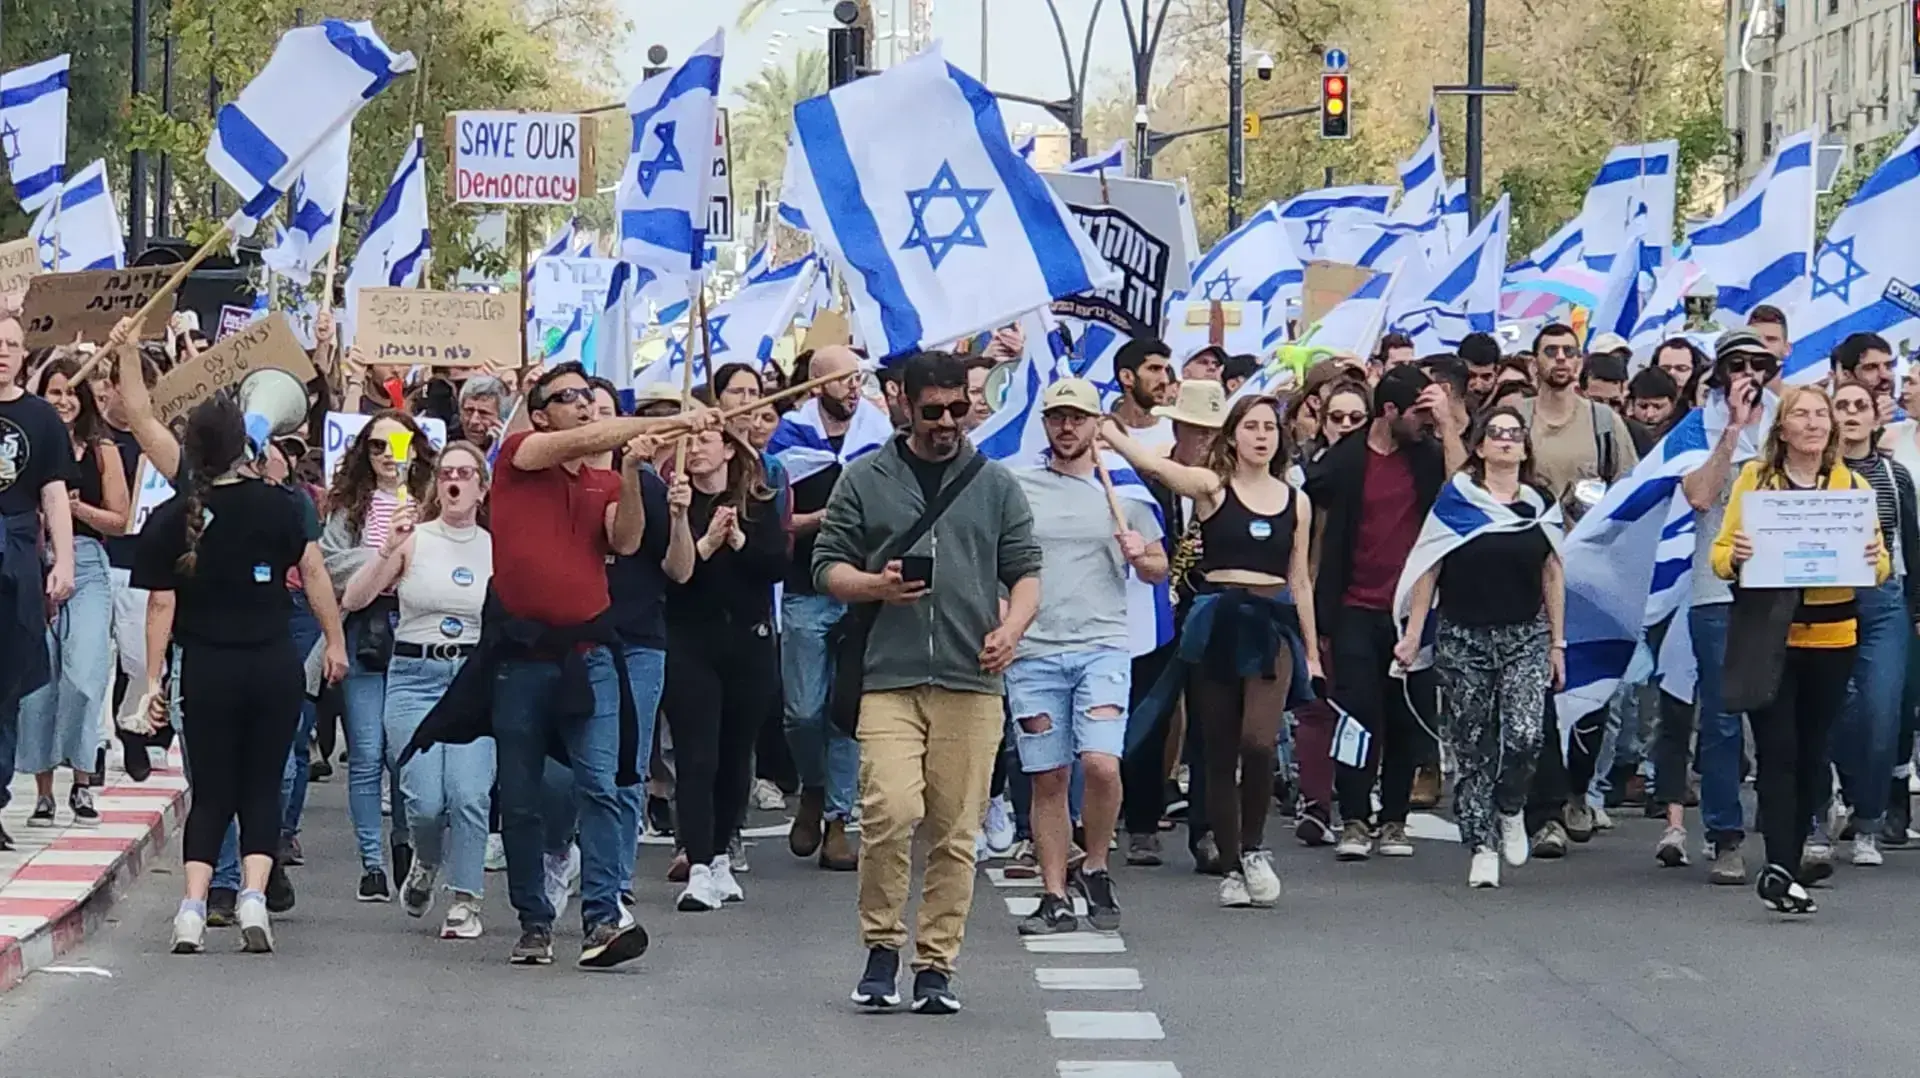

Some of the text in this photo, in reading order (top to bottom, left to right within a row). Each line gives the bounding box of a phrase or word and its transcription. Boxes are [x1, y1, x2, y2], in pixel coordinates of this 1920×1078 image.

[460, 120, 576, 159] SAVE OUR
[458, 169, 577, 202] Democracy
[1126, 276, 1157, 327] זה
[378, 343, 472, 359] לא רוטמן
